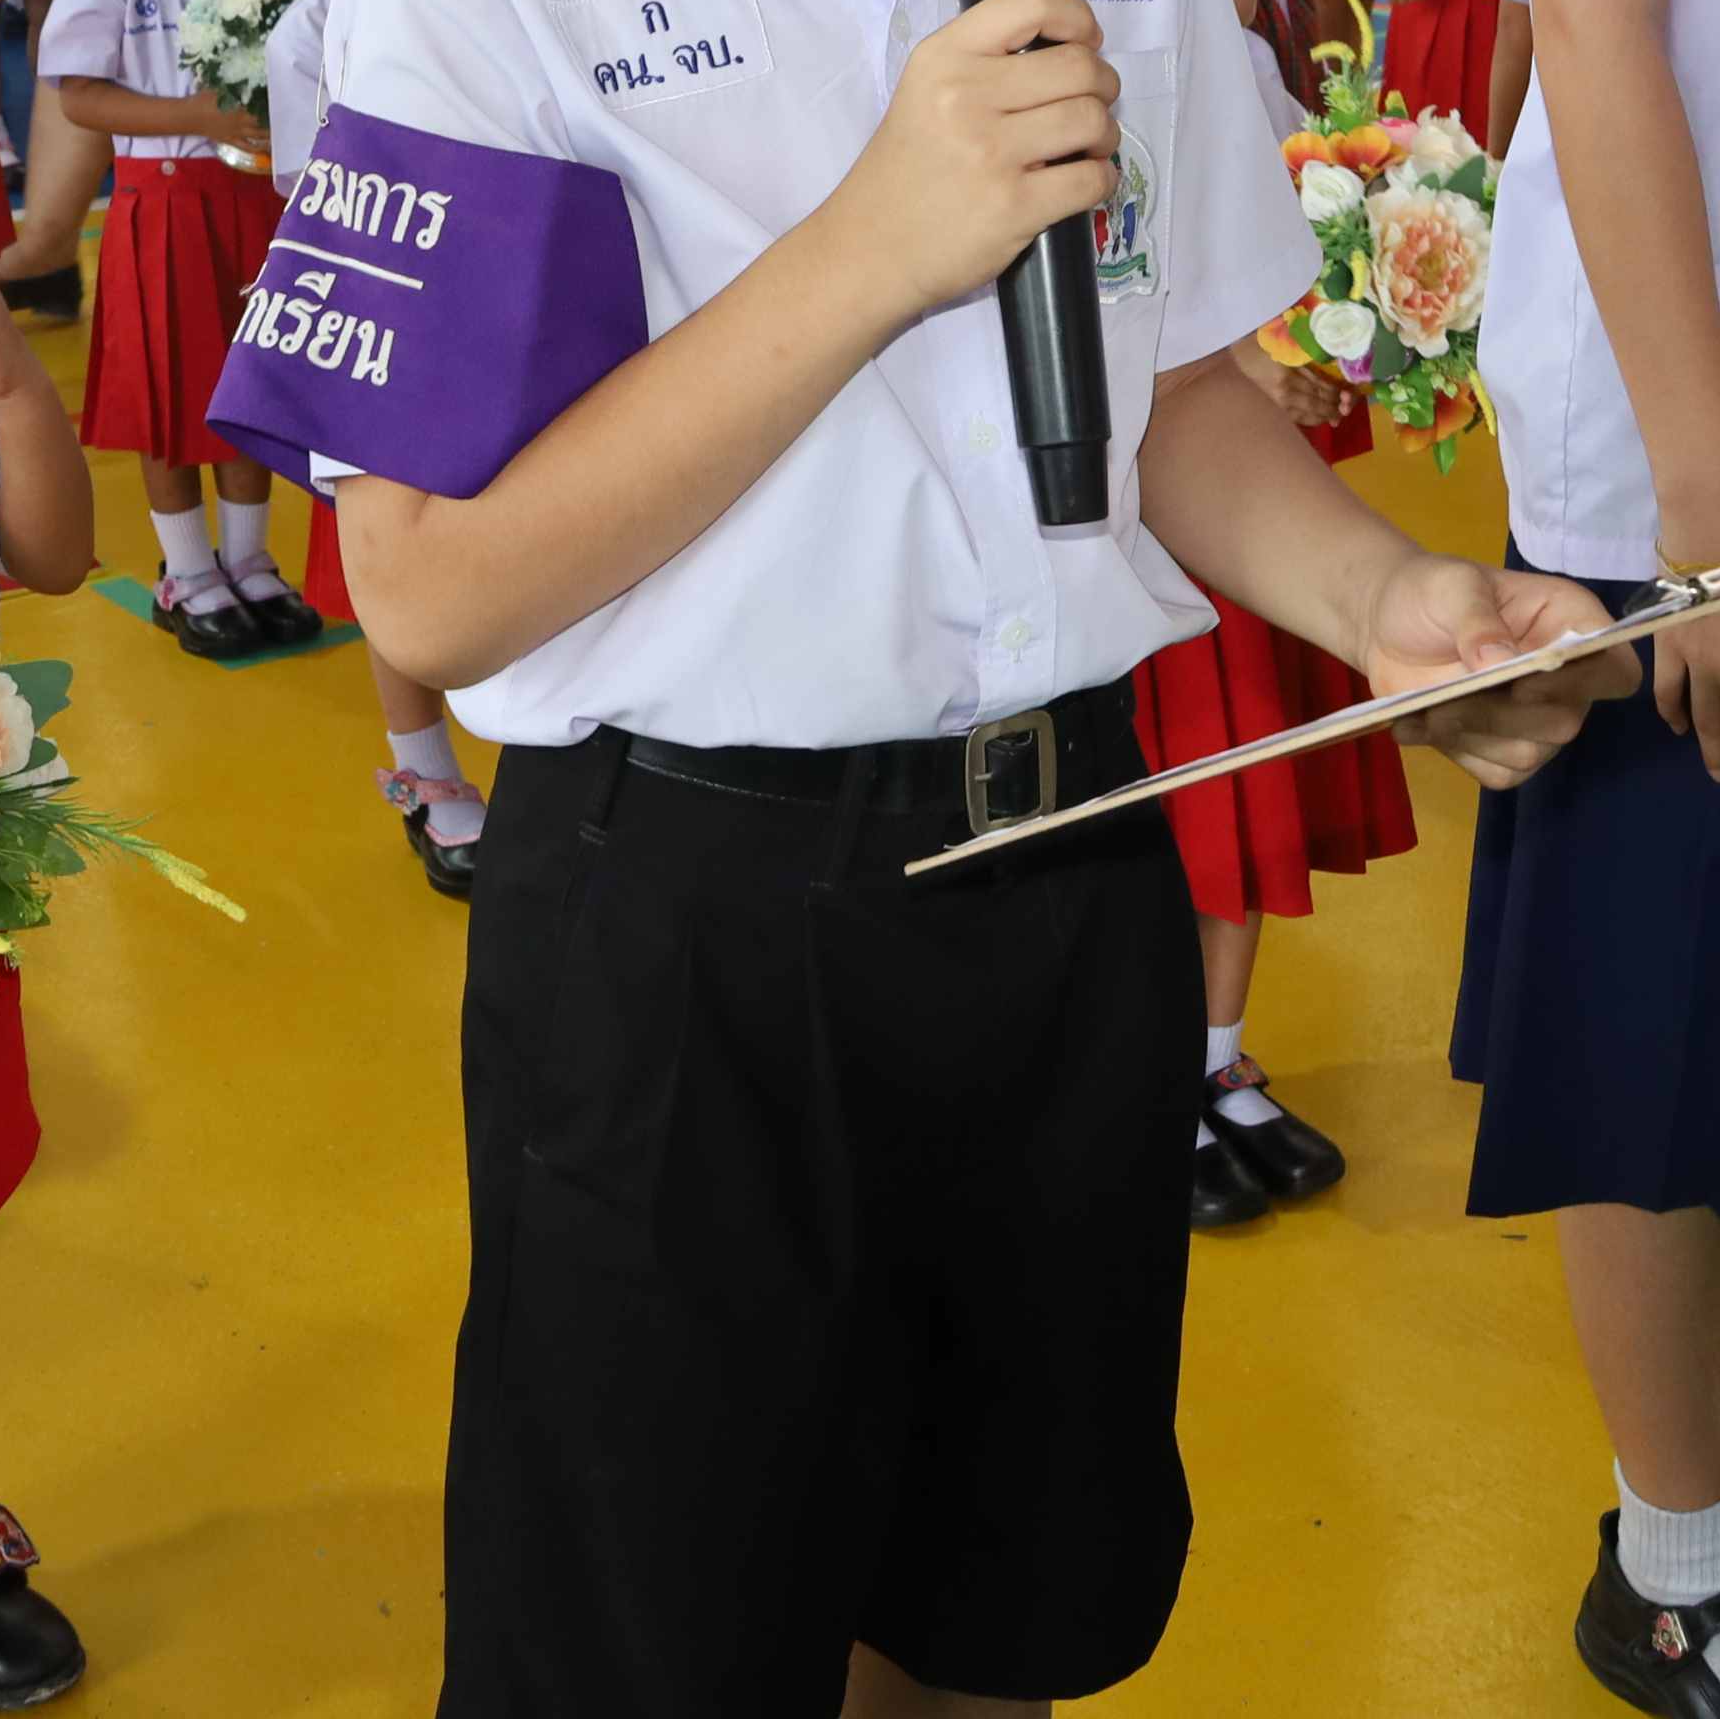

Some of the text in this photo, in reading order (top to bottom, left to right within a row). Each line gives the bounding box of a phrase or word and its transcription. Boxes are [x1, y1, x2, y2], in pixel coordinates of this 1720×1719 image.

[641, 0, 670, 35] ก
[283, 157, 454, 251] รมการ
[230, 262, 396, 388] กเรียน
